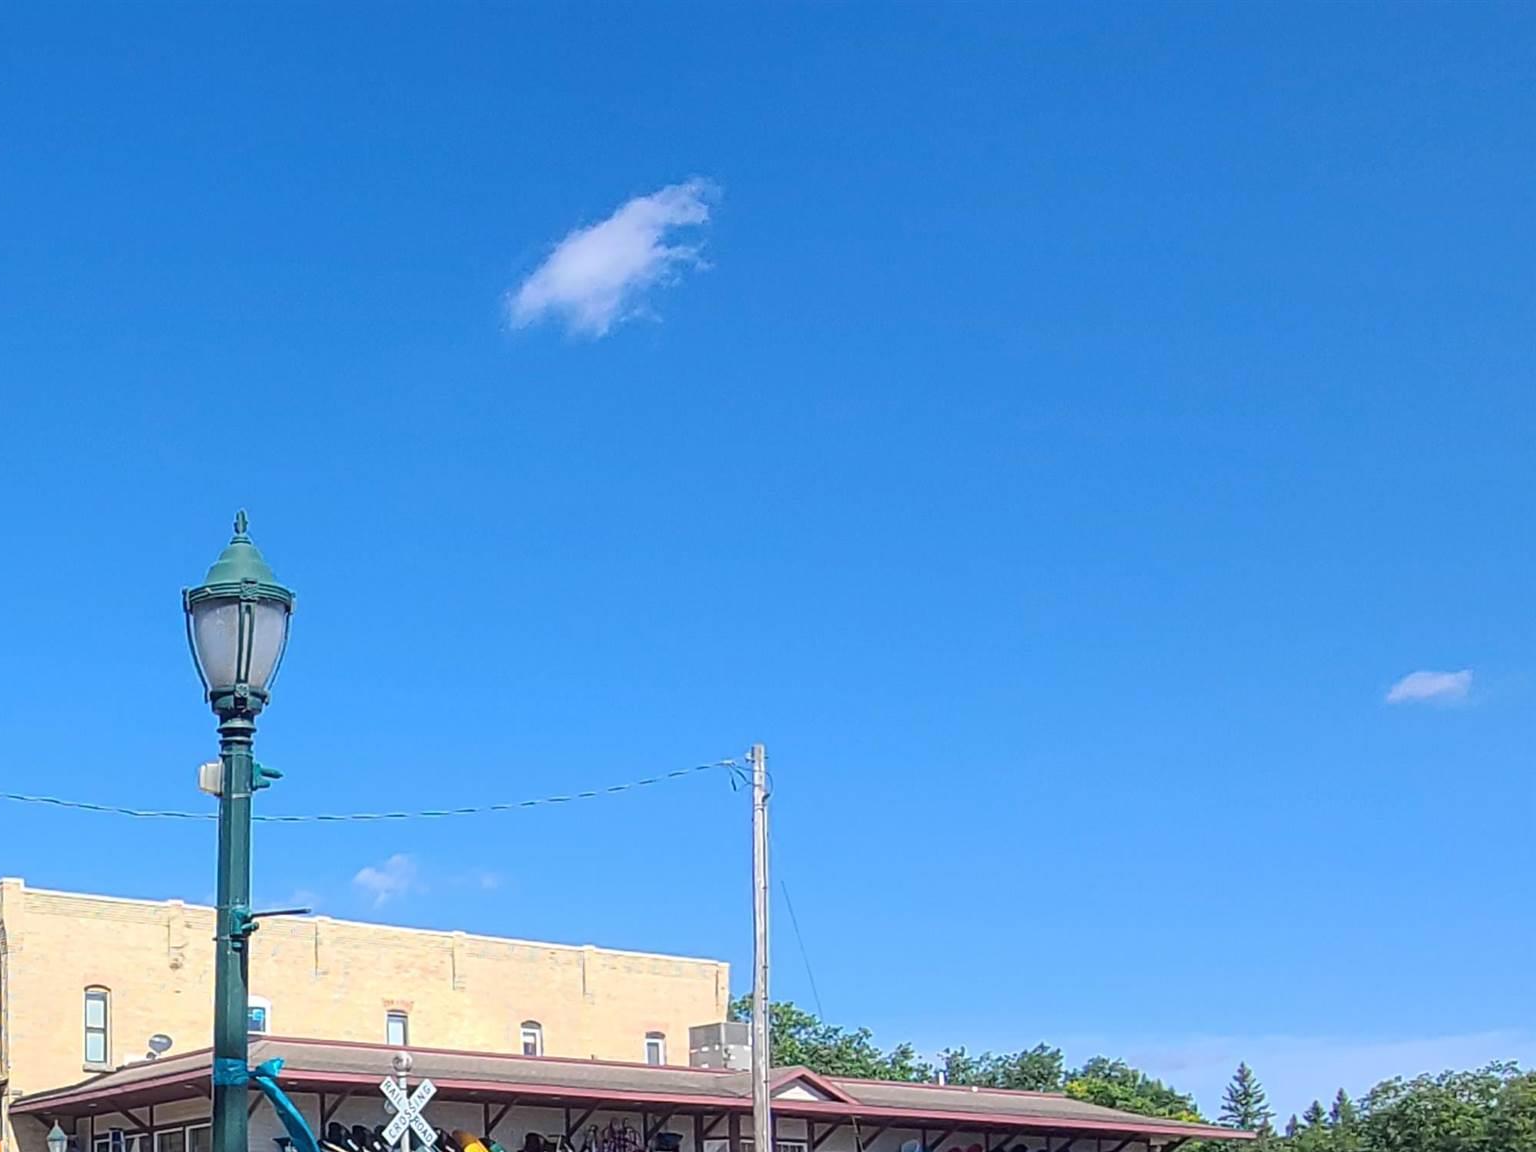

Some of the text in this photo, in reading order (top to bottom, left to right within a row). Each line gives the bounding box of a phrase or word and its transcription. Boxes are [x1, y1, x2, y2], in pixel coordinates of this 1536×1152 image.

[384, 1080, 434, 1143] RAIL ROAD
[388, 1084, 432, 1139] CROSSING
